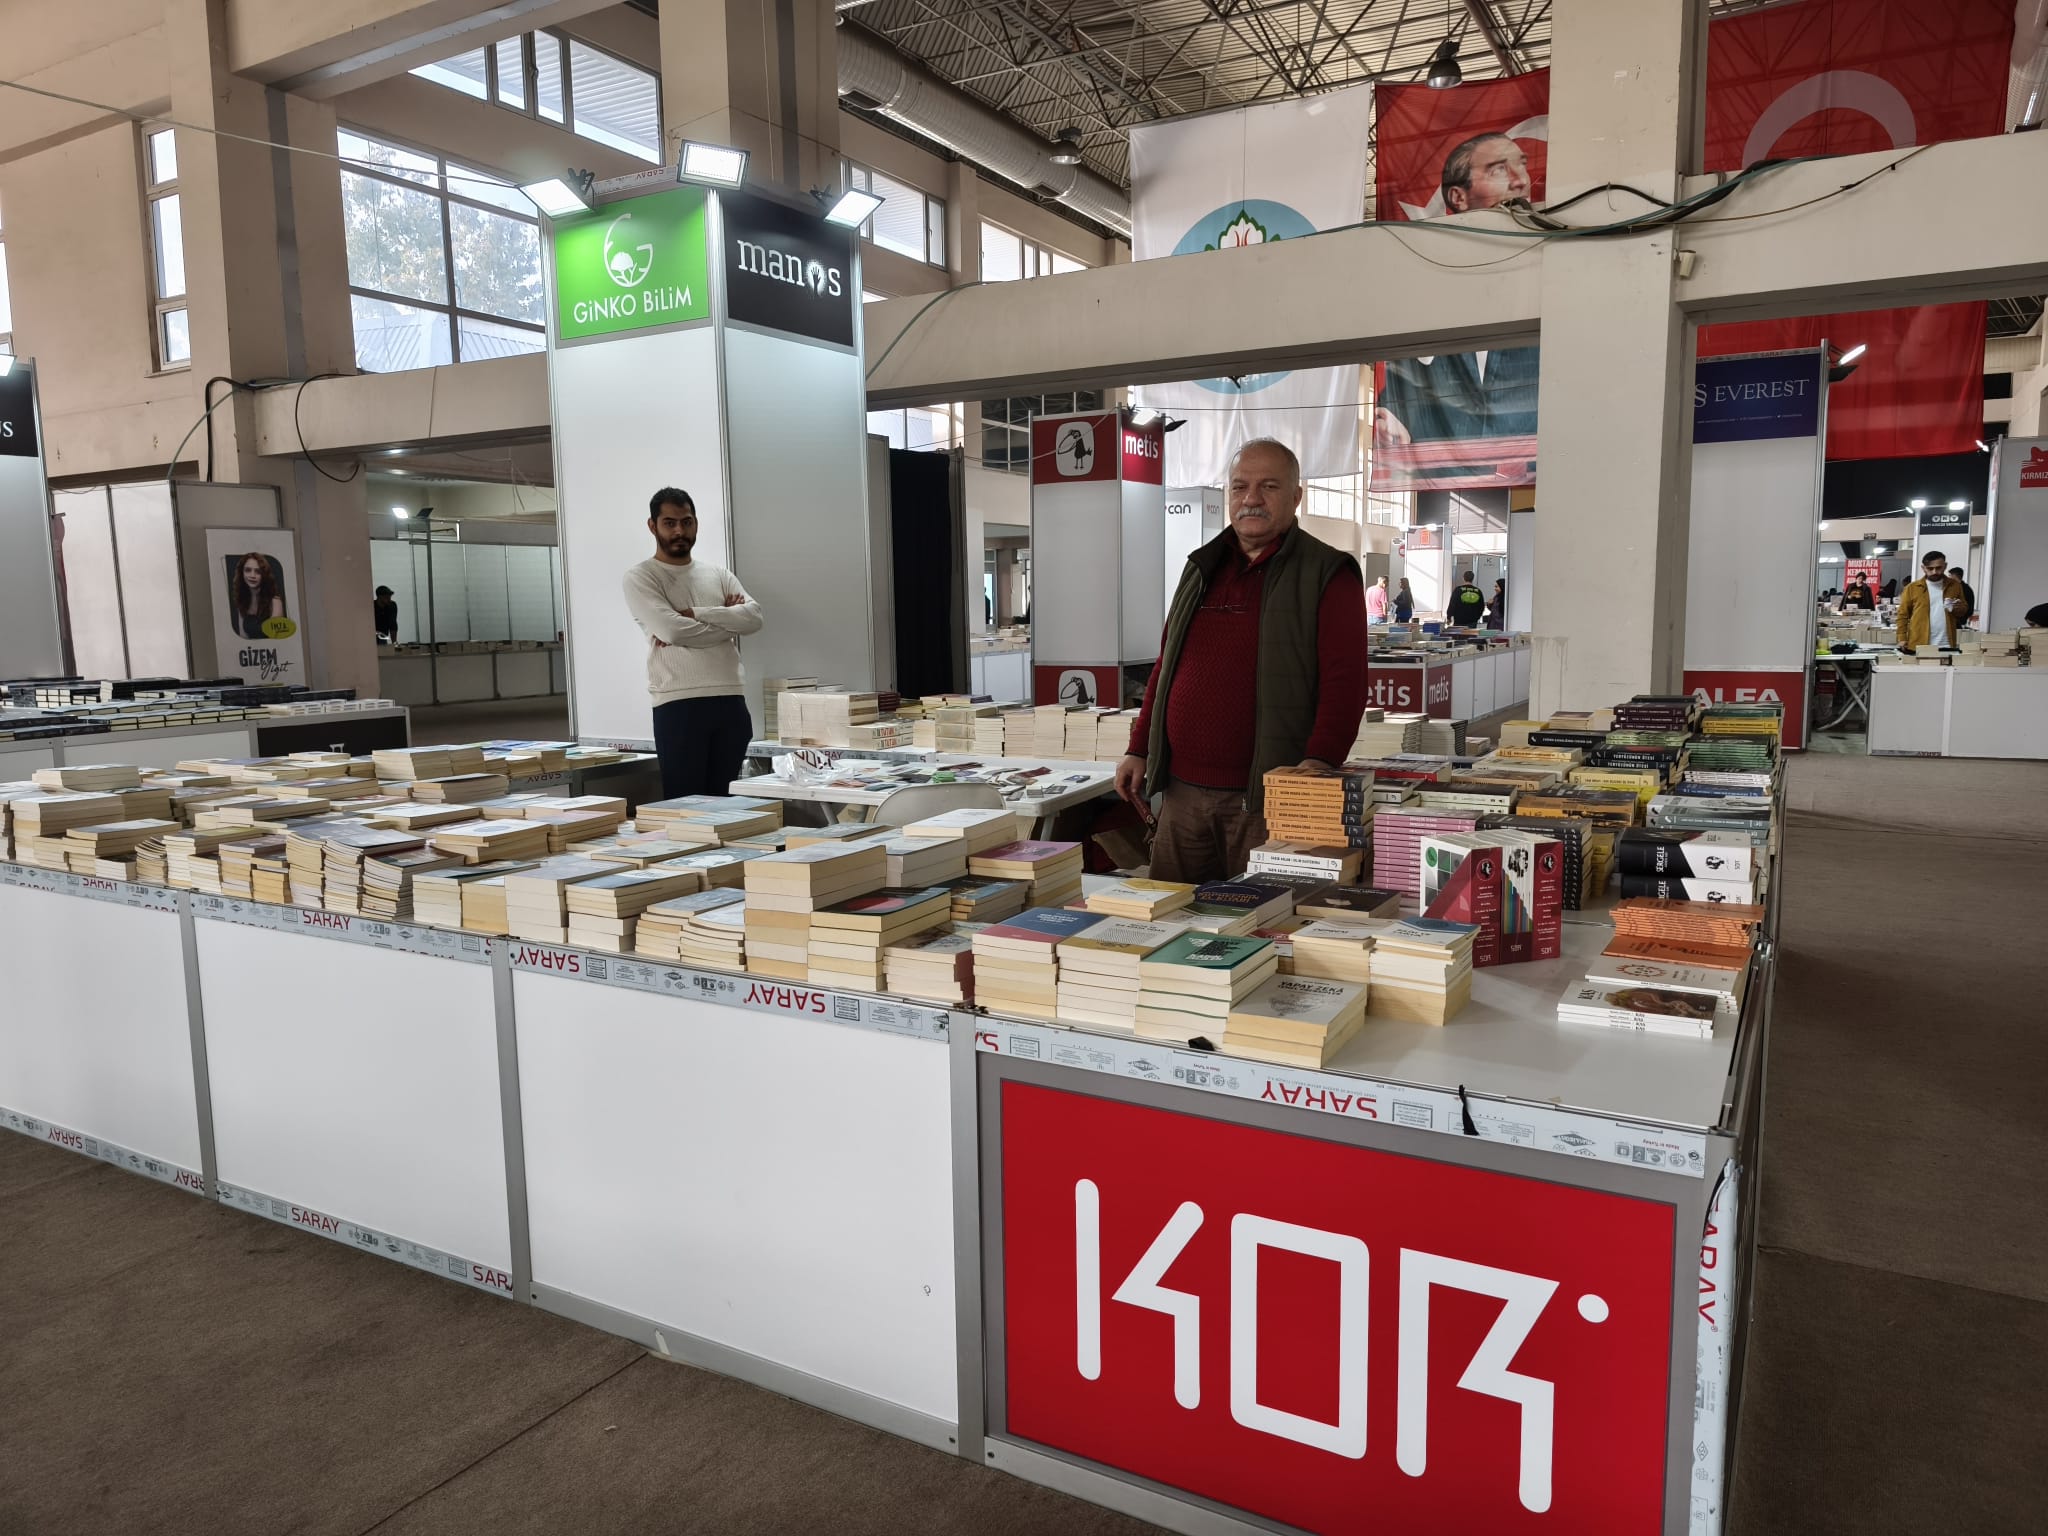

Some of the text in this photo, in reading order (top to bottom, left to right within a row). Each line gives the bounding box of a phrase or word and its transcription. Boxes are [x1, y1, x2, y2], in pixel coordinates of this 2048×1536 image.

[1125, 433, 1159, 460] metis
[1168, 503, 1192, 515] can
[1848, 559, 1878, 568] MUSTAFA
[238, 646, 278, 667] GİZEM
[1428, 674, 1449, 705] metis
[303, 910, 352, 931] SARAY
[517, 946, 580, 974] SARAY
[745, 982, 826, 1014] SARAY
[1261, 1080, 1377, 1119] SARAY
[48, 1127, 83, 1149] SARAY
[291, 1206, 342, 1235] SARAY
